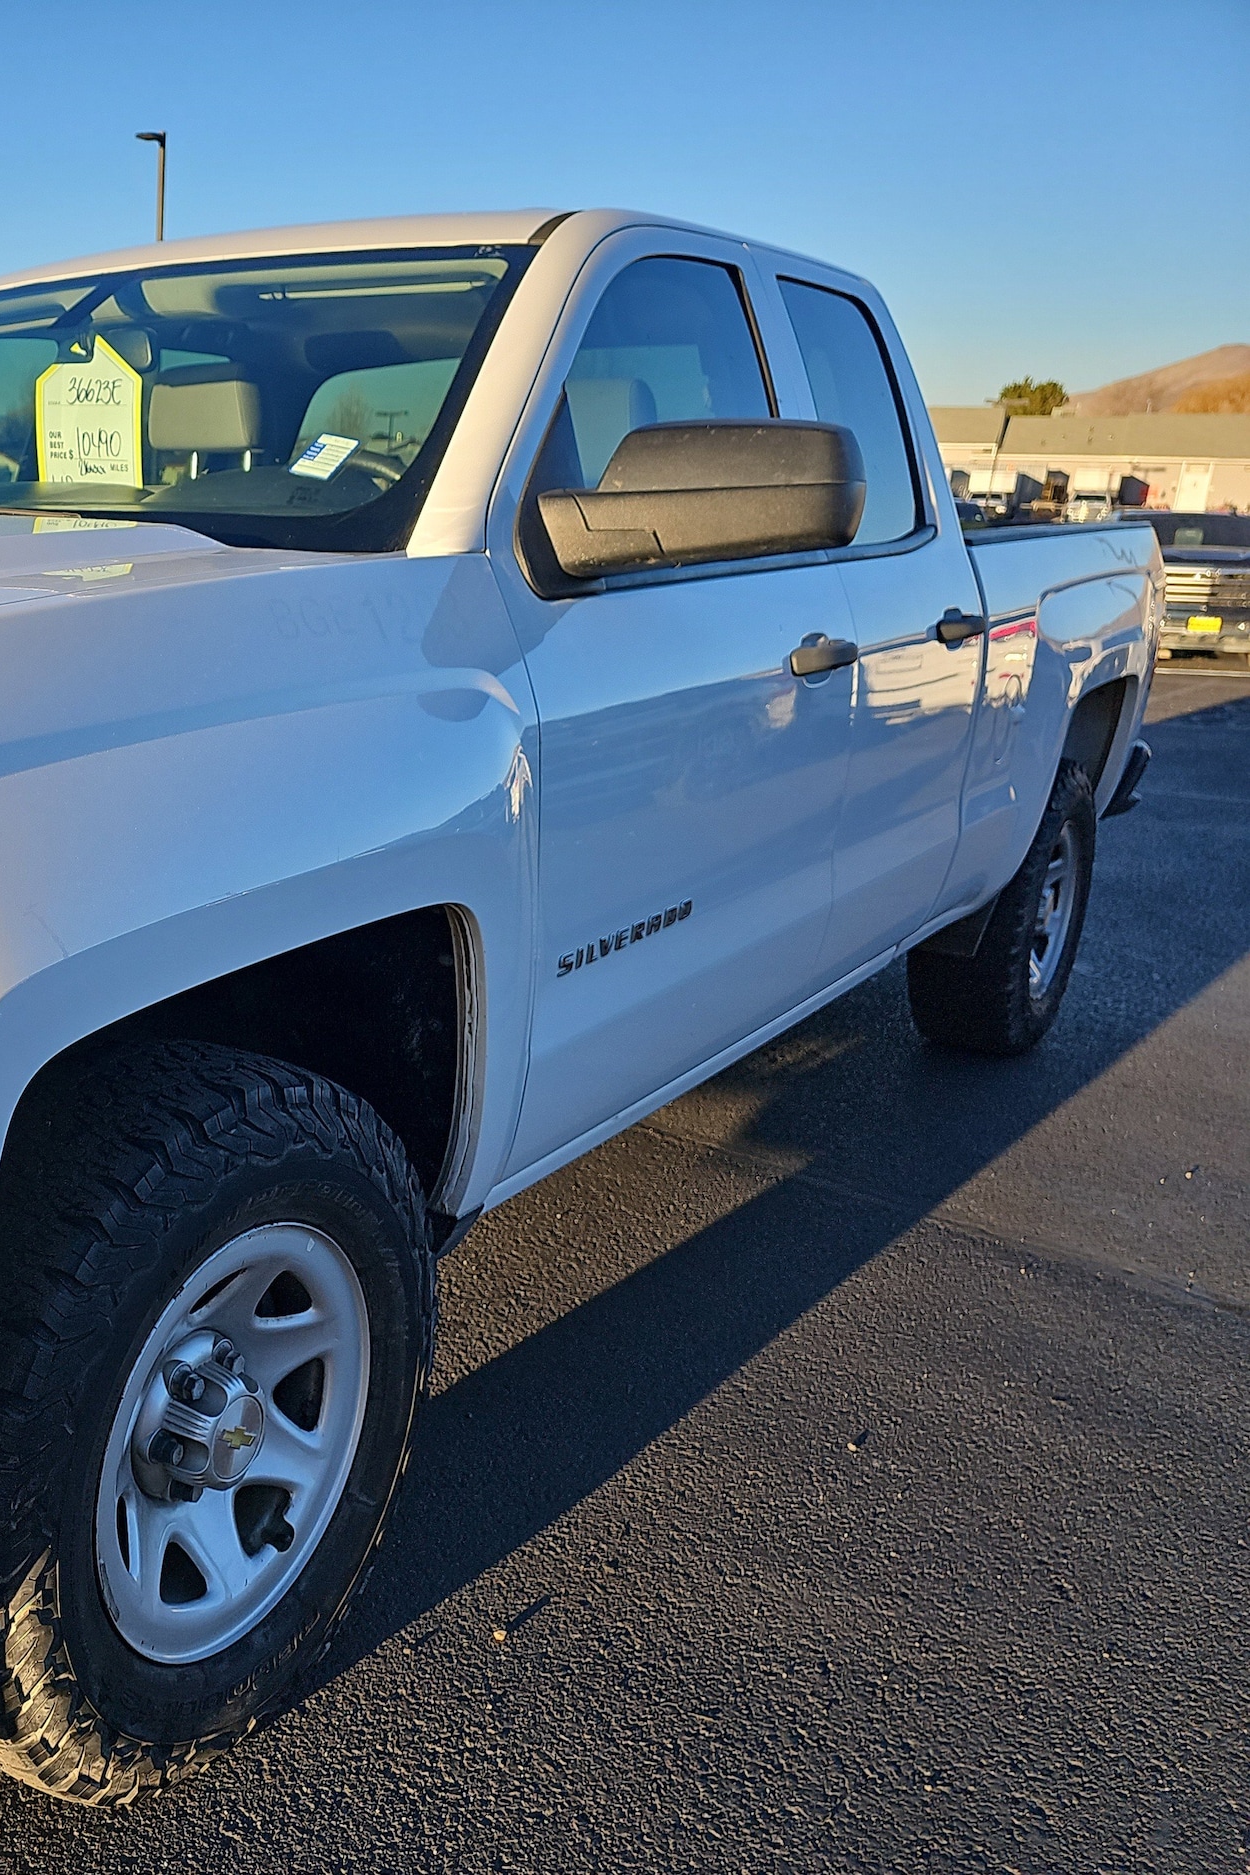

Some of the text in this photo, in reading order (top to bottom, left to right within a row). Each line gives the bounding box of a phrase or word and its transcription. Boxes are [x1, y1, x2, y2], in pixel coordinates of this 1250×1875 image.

[49, 431, 62, 439] OUR
[50, 441, 64, 449] BEST
[50, 451, 67, 459] PRICE
[110, 463, 129, 472] MILES
[556, 897, 693, 978] SILVERADO
